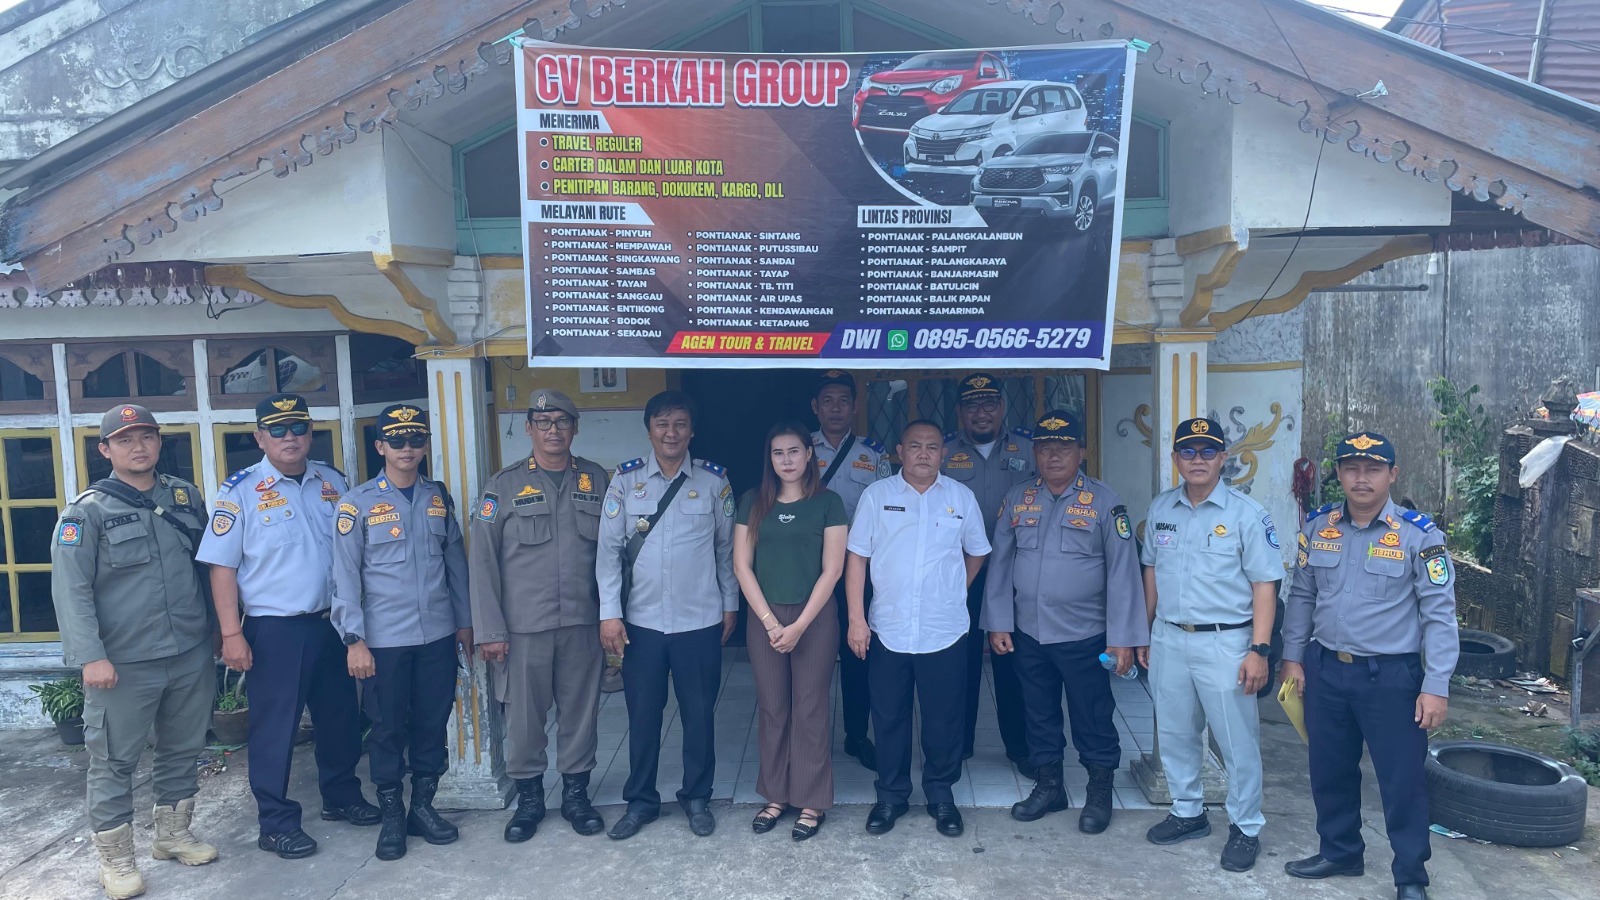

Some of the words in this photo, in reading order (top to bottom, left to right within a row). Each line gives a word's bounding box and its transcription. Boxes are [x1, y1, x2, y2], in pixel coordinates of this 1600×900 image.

[535, 54, 581, 105] CV
[590, 56, 725, 107] BERKAH
[734, 59, 850, 107] GROUP
[540, 113, 600, 130] MENERIMA
[553, 135, 593, 151] TRAVEL
[596, 136, 642, 152] REGULER
[553, 158, 594, 173] CARTER
[598, 159, 636, 174] DALAM
[640, 160, 662, 175] DAN
[665, 160, 693, 175] LUAR
[696, 160, 724, 175] KOTA
[554, 181, 608, 195] PENITIPAN
[613, 181, 659, 198] BARANG,
[663, 182, 718, 199] DOKUKEM,
[722, 183, 761, 199] KARGO,
[765, 183, 784, 198] DLL
[541, 205, 597, 221] MELAYANI
[600, 205, 626, 221] RUTE
[862, 209, 899, 224] LINTAS
[902, 209, 952, 224] PROVINSI
[551, 229, 607, 237] PONTIANAK
[616, 229, 651, 237] PINYUH
[696, 231, 752, 240] PONTIANAK
[760, 231, 801, 240] SINTANG
[868, 233, 923, 241] PONTIANAK
[932, 233, 1022, 241] PALANGKALANBUN
[552, 242, 608, 250] PONTIANAK
[616, 242, 671, 251] MEMPAWAH
[696, 244, 752, 253] PONTIANAK
[760, 244, 818, 253] PUTUSSIBAU
[868, 245, 923, 253] PONTIANAK
[932, 245, 966, 253] SAMPIT
[552, 255, 608, 263] PONTIANAK
[616, 255, 681, 264] SINGKAWANG
[696, 257, 752, 265] PONTIANAK
[760, 257, 795, 265] SANDAI
[552, 267, 608, 275] PONTIANAK
[616, 268, 656, 276] SAMBAS
[696, 269, 752, 278] PONTIANAK
[760, 269, 789, 278] TAYAP
[617, 280, 647, 288] TAYAN
[696, 282, 752, 290] PONTIANAK
[760, 282, 773, 290] TB.
[775, 282, 794, 290] TITI
[552, 292, 608, 300] PONTIANAK
[617, 292, 663, 301] SANGGAU
[696, 294, 752, 303] PONTIANAK
[760, 294, 776, 303] AIR
[778, 294, 802, 303] UPAS
[867, 295, 922, 303] PONTIANAK
[930, 295, 957, 303] BALIK
[959, 295, 990, 303] PAPAN
[552, 304, 608, 313] PONTIANAK
[617, 305, 665, 313] ENTIKONG
[696, 306, 752, 315] PONTIANAK
[760, 306, 833, 315] KENDAWANGAN
[867, 307, 922, 315] PONTIANAK
[930, 307, 984, 315] SAMARINDA
[553, 316, 609, 325] PONTIANAK
[617, 317, 650, 325] BODOK
[696, 319, 752, 327] PONTIANAK
[760, 319, 810, 327] KETAPANG
[553, 329, 609, 337] PONTIANAK
[617, 330, 662, 338] SEKADAU
[681, 336, 715, 349] AGEN
[720, 336, 752, 350] TOUR
[755, 337, 764, 350] &
[768, 337, 813, 350] TRAVEL
[841, 329, 881, 349] DWI
[914, 328, 1091, 349] 0895-0566-5279
